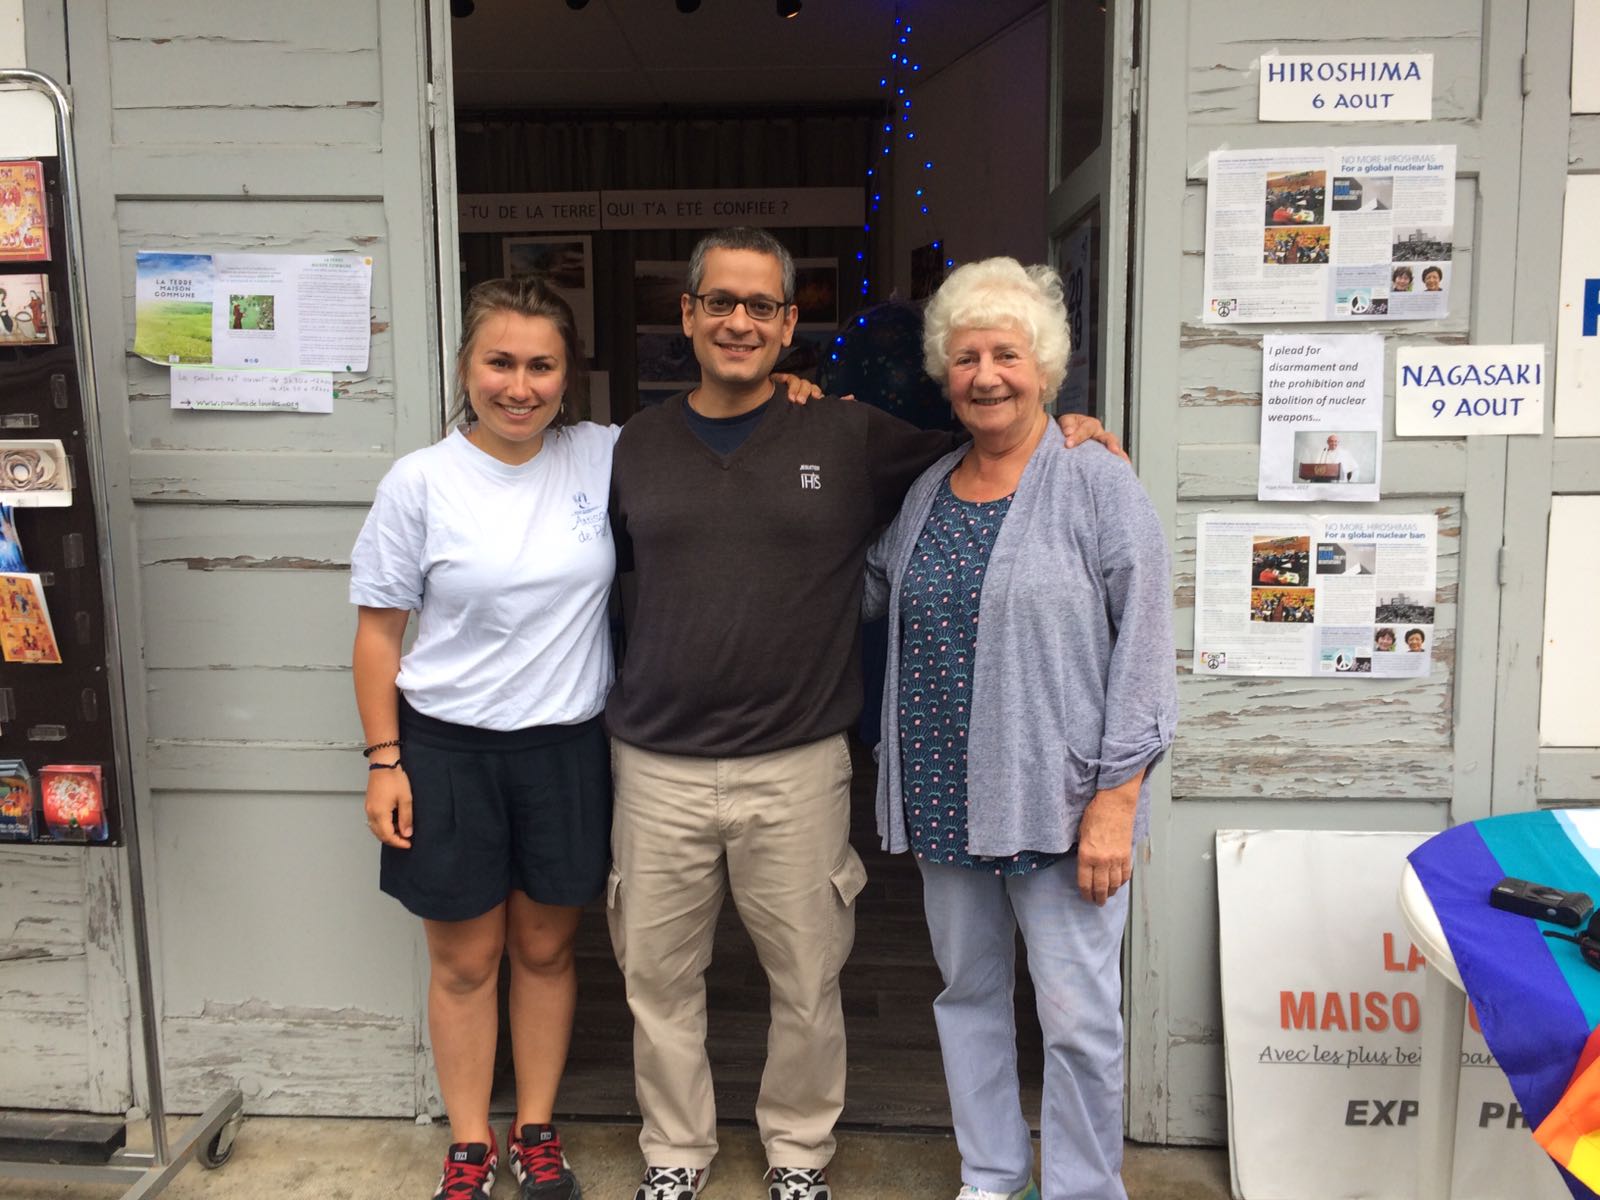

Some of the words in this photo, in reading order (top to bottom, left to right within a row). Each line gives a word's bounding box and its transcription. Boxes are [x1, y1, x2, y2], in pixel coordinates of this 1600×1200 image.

[1268, 62, 1422, 83] HIROSHIMA
[1312, 94, 1325, 109] 6
[1334, 93, 1395, 109] AOUT
[1341, 155, 1354, 165] NO
[1357, 154, 1380, 164] MORE
[1341, 164, 1355, 172] For
[1364, 163, 1392, 173] global
[1394, 163, 1425, 171] nuclear
[1427, 163, 1444, 171] ban
[499, 205, 517, 219] DE
[526, 205, 544, 219] LA
[552, 204, 596, 218] TERRE
[607, 202, 635, 217] QUI
[1268, 346, 1273, 355] I
[1274, 345, 1304, 357] plead
[1305, 345, 1322, 357] for
[1268, 362, 1337, 372] disarmament
[1338, 362, 1359, 372] and
[1401, 363, 1542, 388] NAGASAKI
[1268, 379, 1286, 388] the
[1287, 379, 1344, 390] prohibition
[1345, 379, 1366, 388] and
[1268, 395, 1314, 405] abolition
[1315, 395, 1328, 407] of
[1328, 396, 1367, 405] nuclear
[1431, 398, 1447, 419] 9
[1454, 397, 1525, 418] AOUT
[800, 472, 822, 490] IHS
[1325, 531, 1338, 539] For
[1347, 531, 1374, 540] global
[1376, 531, 1408, 539] nuclear
[1409, 531, 1426, 539] ban
[1279, 990, 1422, 1033] MAISO
[1259, 1045, 1309, 1063] Avec
[1312, 1045, 1344, 1063] les
[1346, 1045, 1392, 1068] plus
[1344, 1099, 1420, 1127] EXP
[1478, 1101, 1528, 1130] PH
